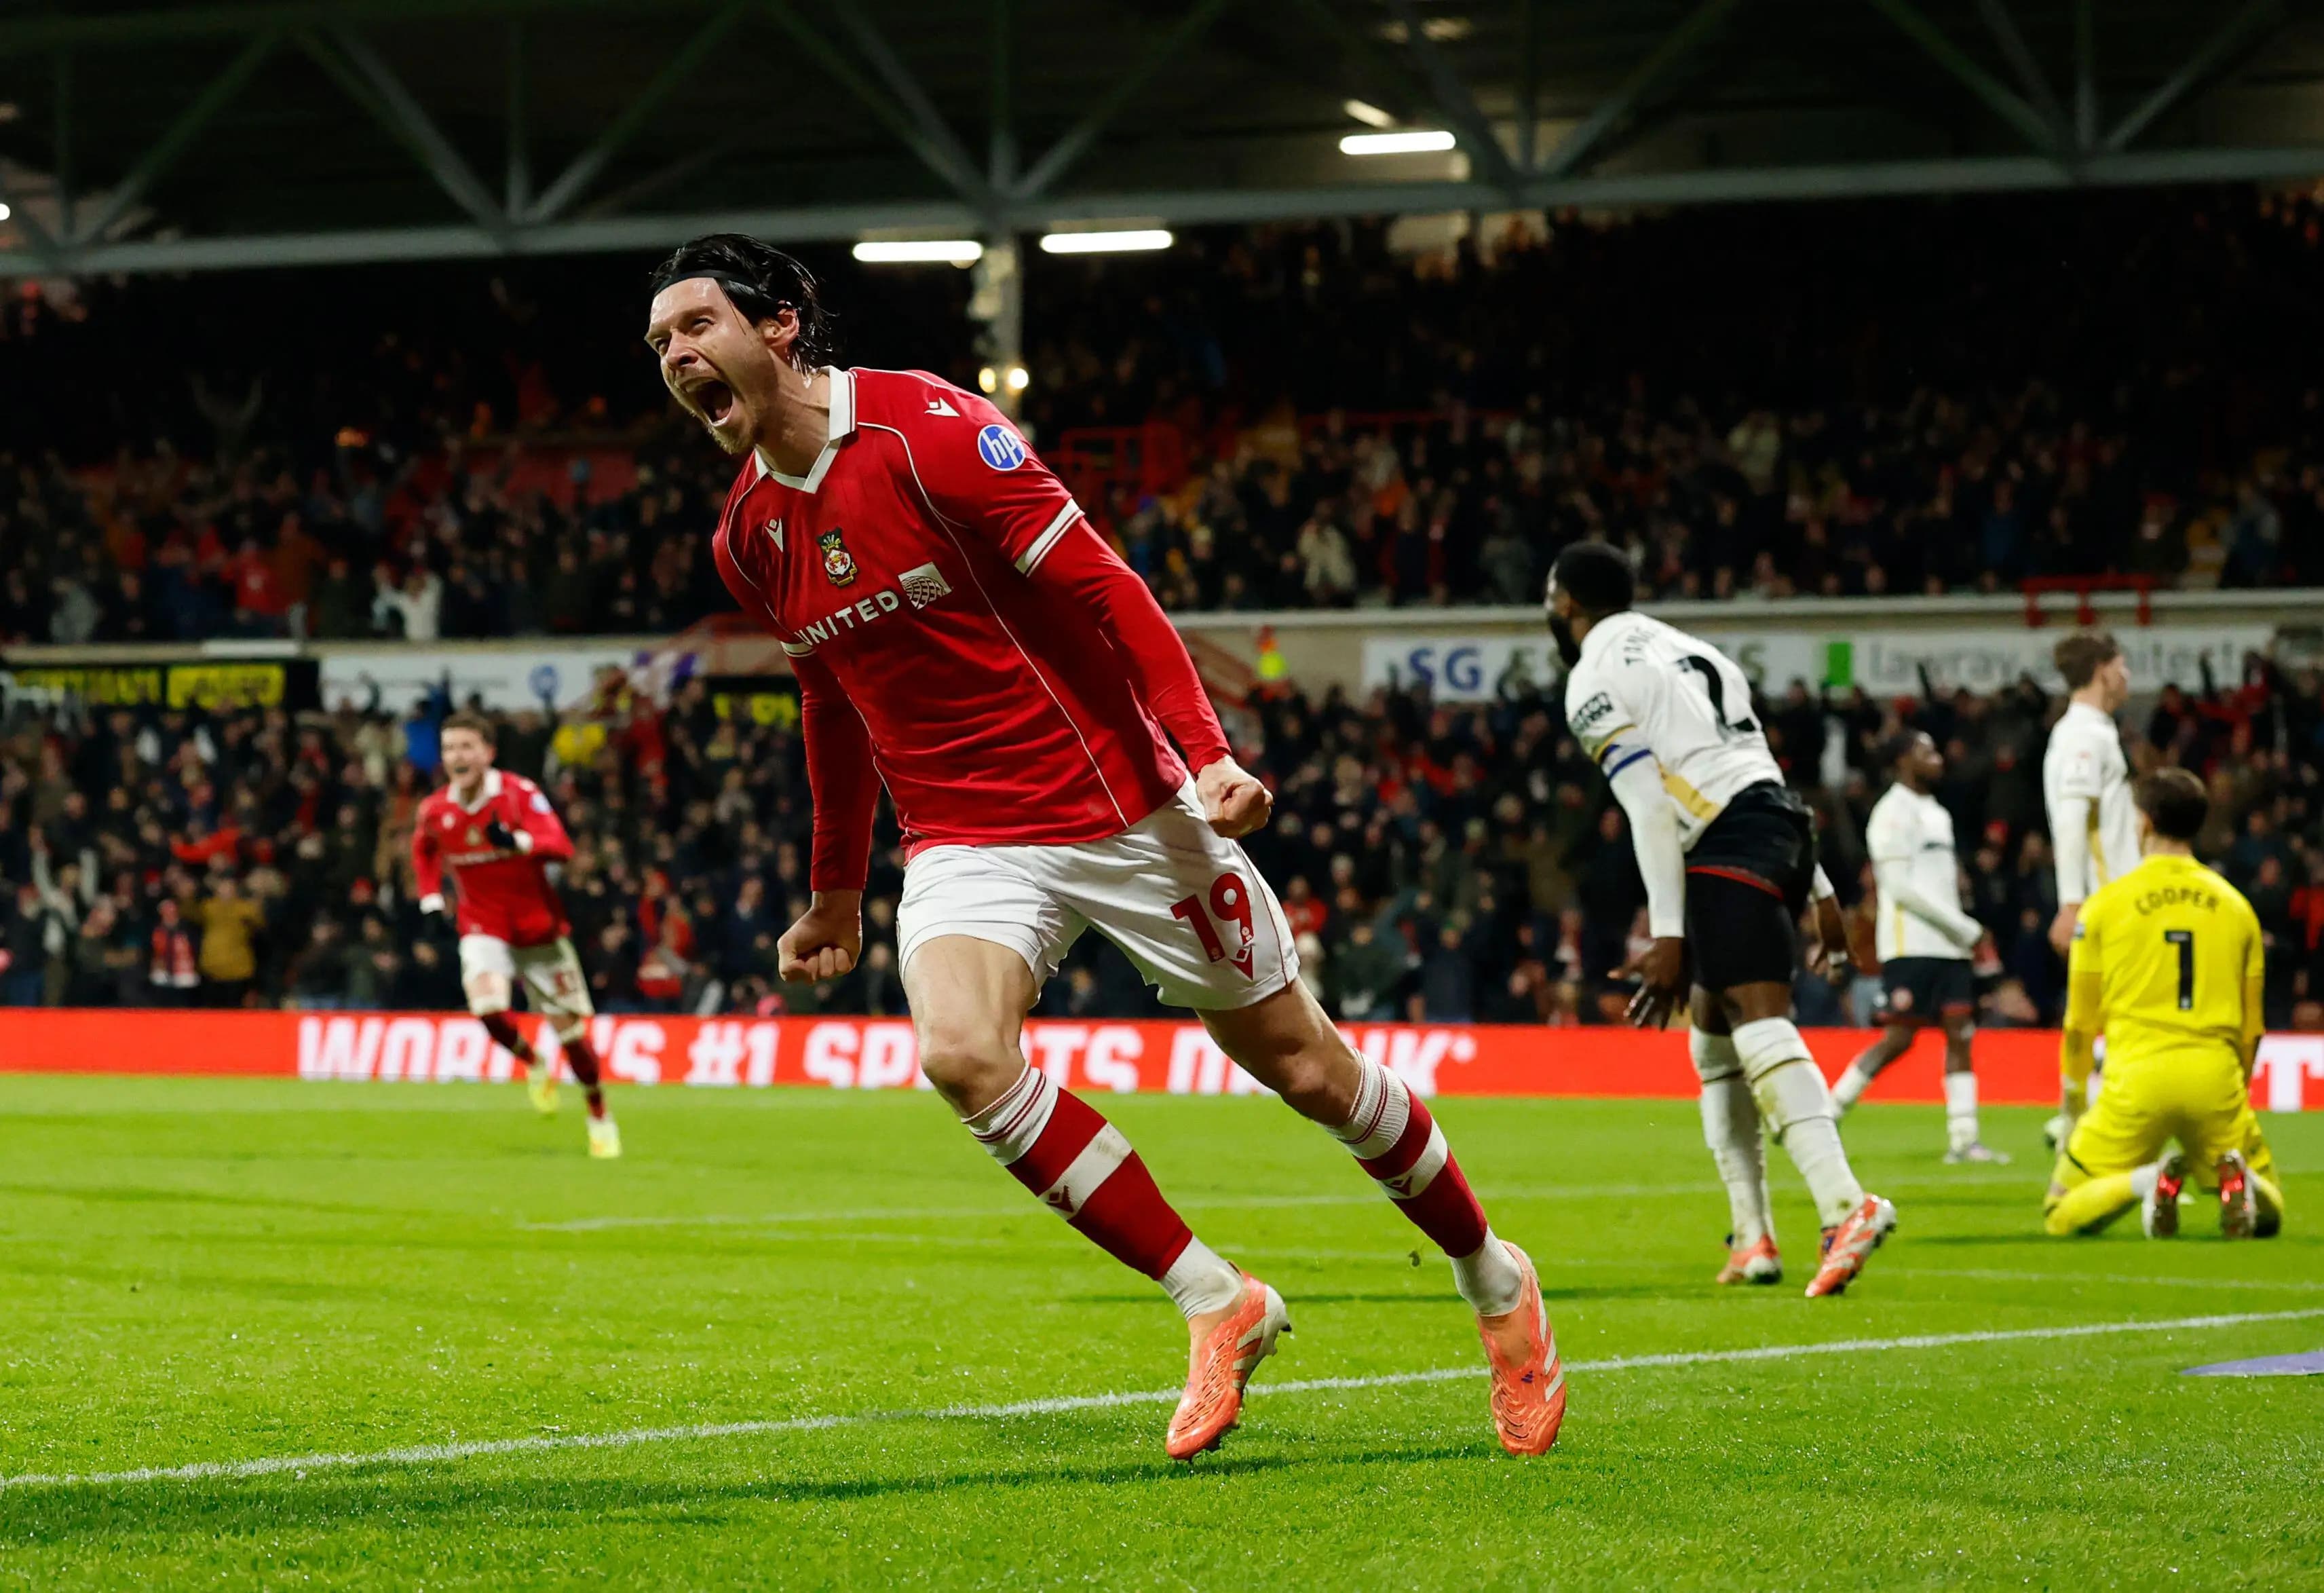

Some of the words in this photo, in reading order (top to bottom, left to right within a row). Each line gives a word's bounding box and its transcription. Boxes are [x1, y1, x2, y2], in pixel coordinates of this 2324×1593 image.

[980, 426, 1023, 468] hp
[794, 591, 899, 645] UNITED
[1170, 872, 1254, 962] 19
[2135, 886, 2220, 916] COOPER
[2164, 930, 2193, 1011] 1
[803, 1022, 1143, 1094] SPTS
